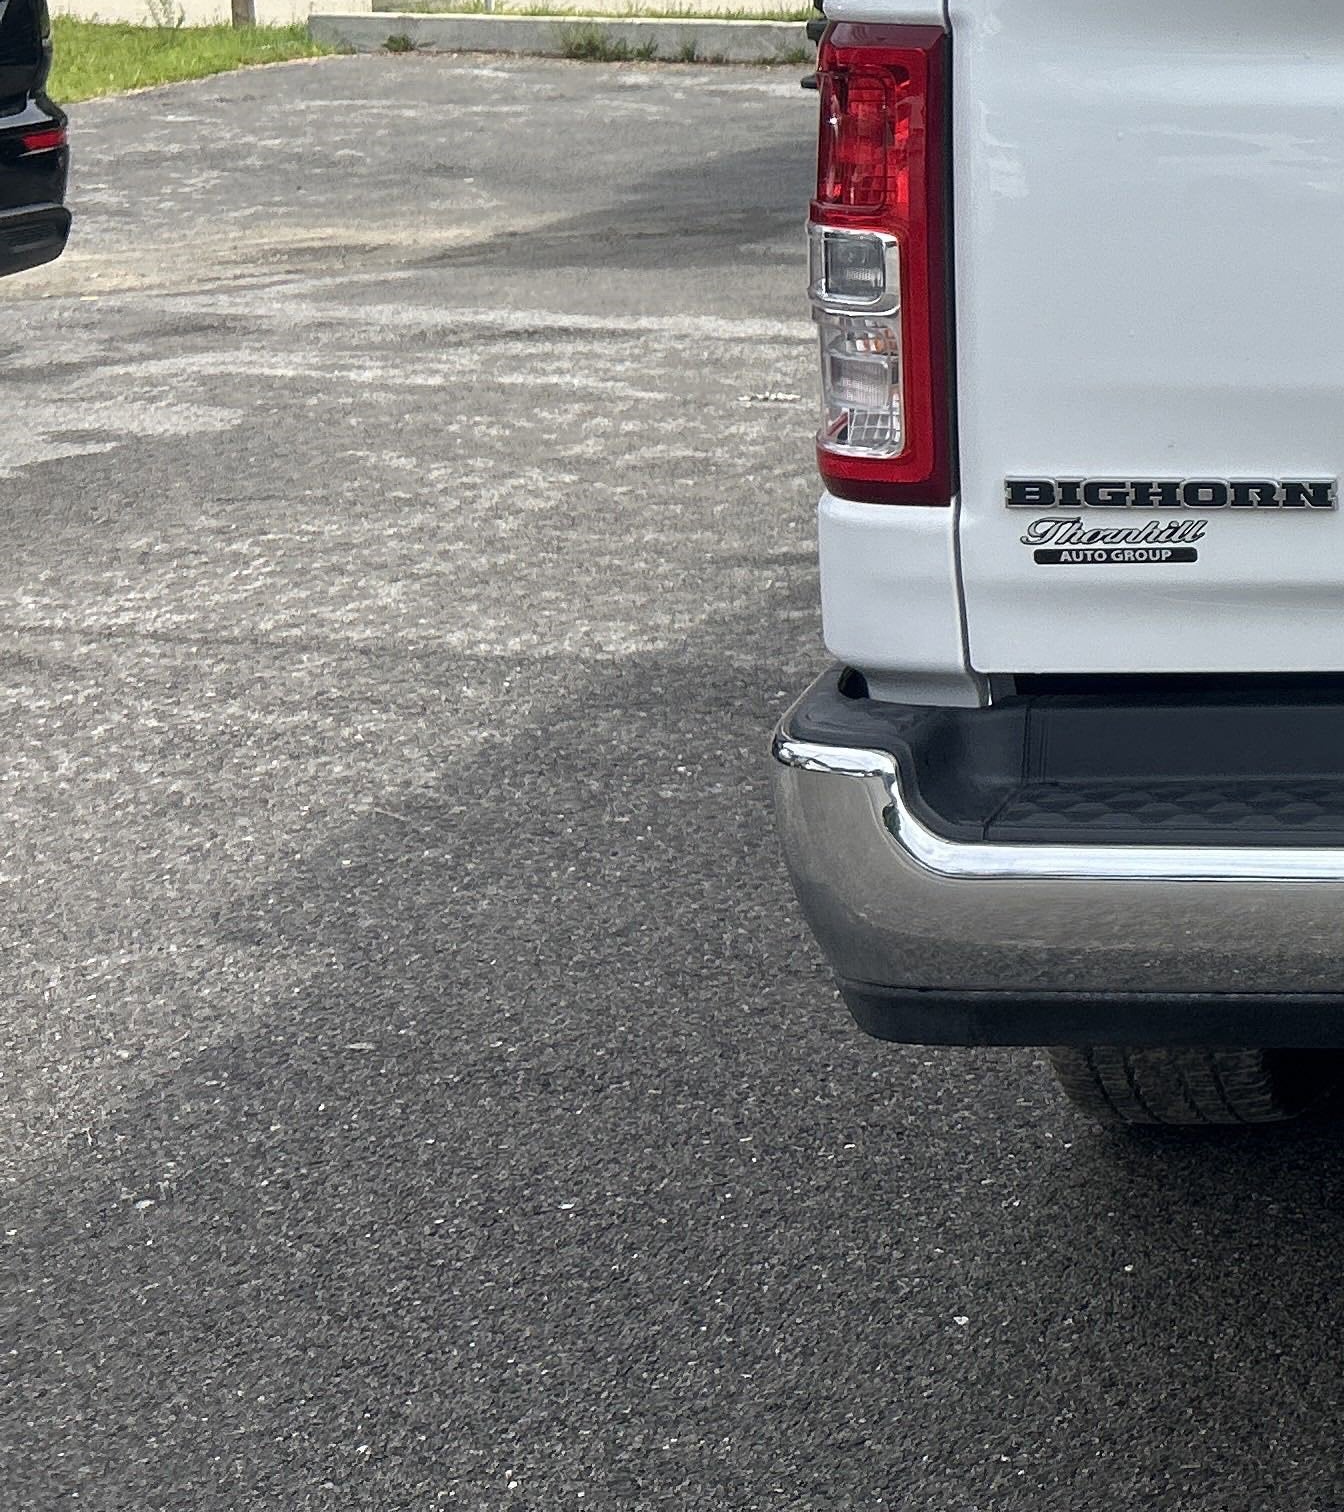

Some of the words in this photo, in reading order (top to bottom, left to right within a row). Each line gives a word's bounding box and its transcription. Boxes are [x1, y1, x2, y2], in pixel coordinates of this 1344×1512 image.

[1004, 475, 1339, 510] BIGHORN
[1020, 516, 1208, 546] Thornhill
[1059, 550, 1104, 563] AUTO
[1110, 549, 1173, 562] GROUP
